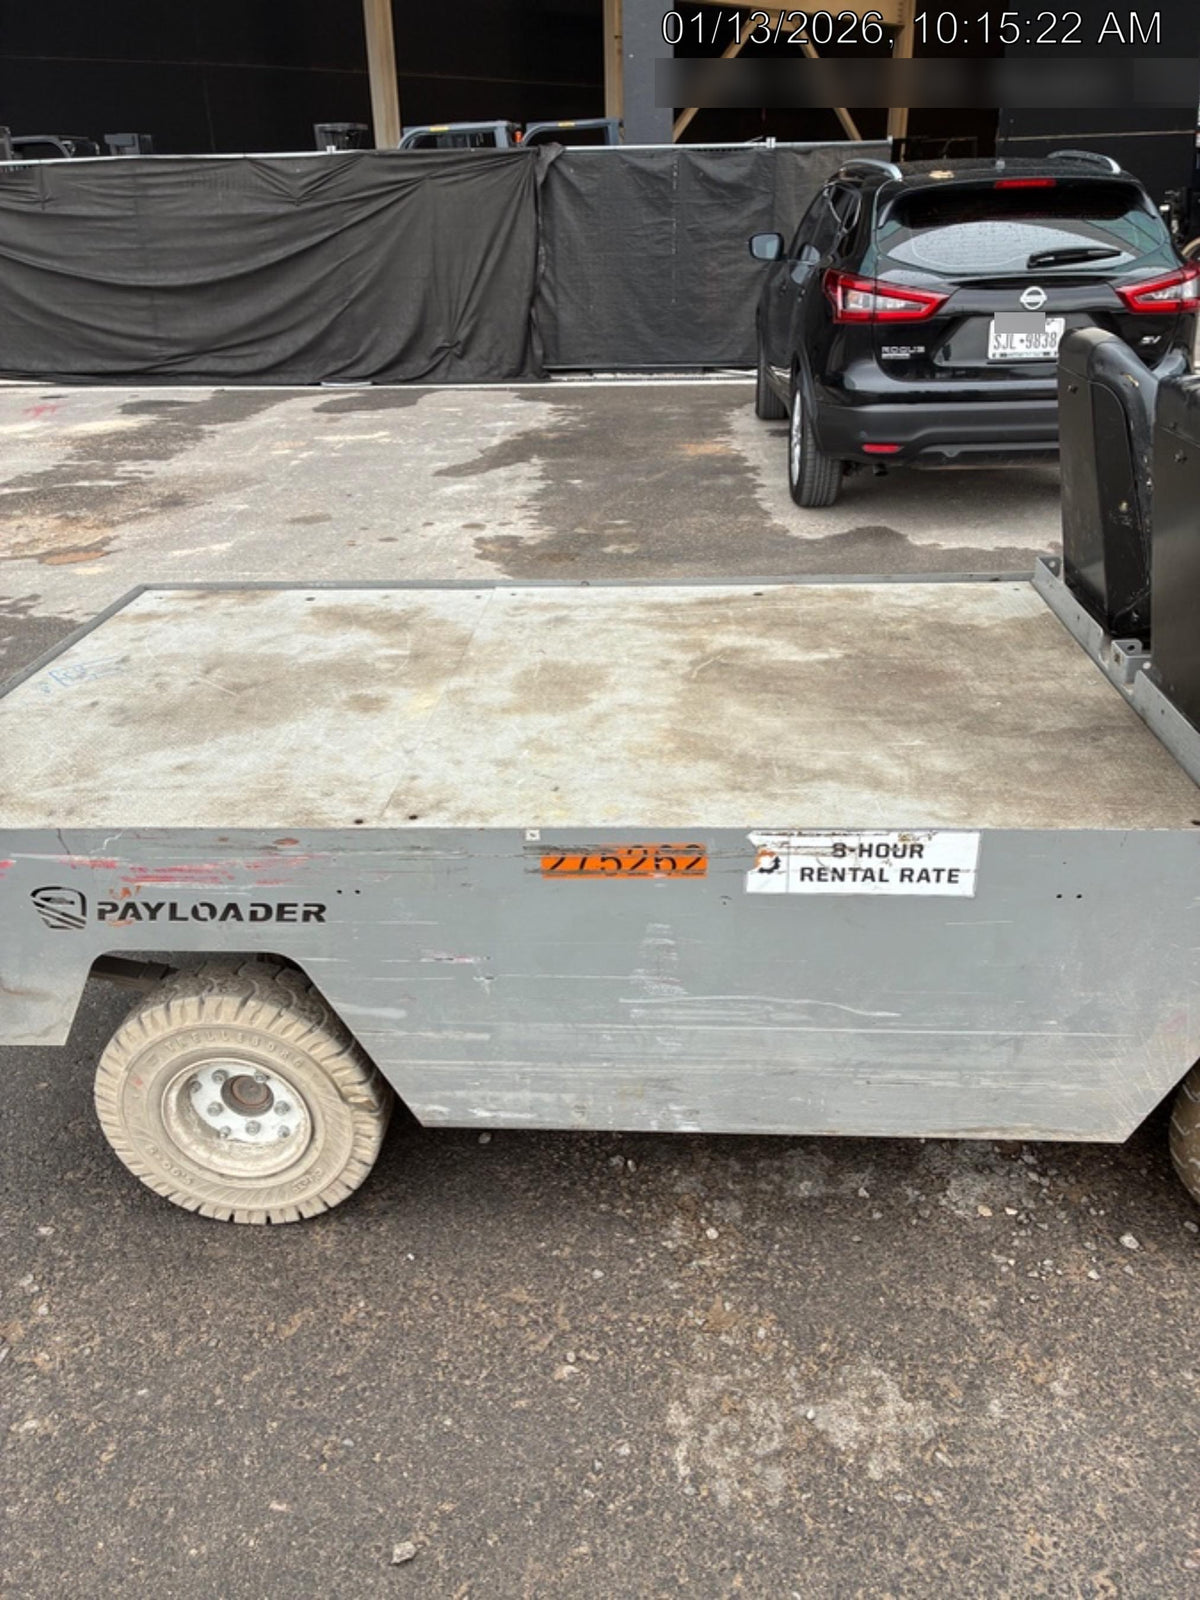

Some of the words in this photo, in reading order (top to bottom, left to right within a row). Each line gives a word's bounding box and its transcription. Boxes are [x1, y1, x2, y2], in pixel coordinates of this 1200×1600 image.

[832, 842, 924, 859] 8-HOUR
[800, 867, 889, 883] RENTAL
[899, 868, 960, 884] RATE
[97, 902, 327, 923] PAYLOADER
